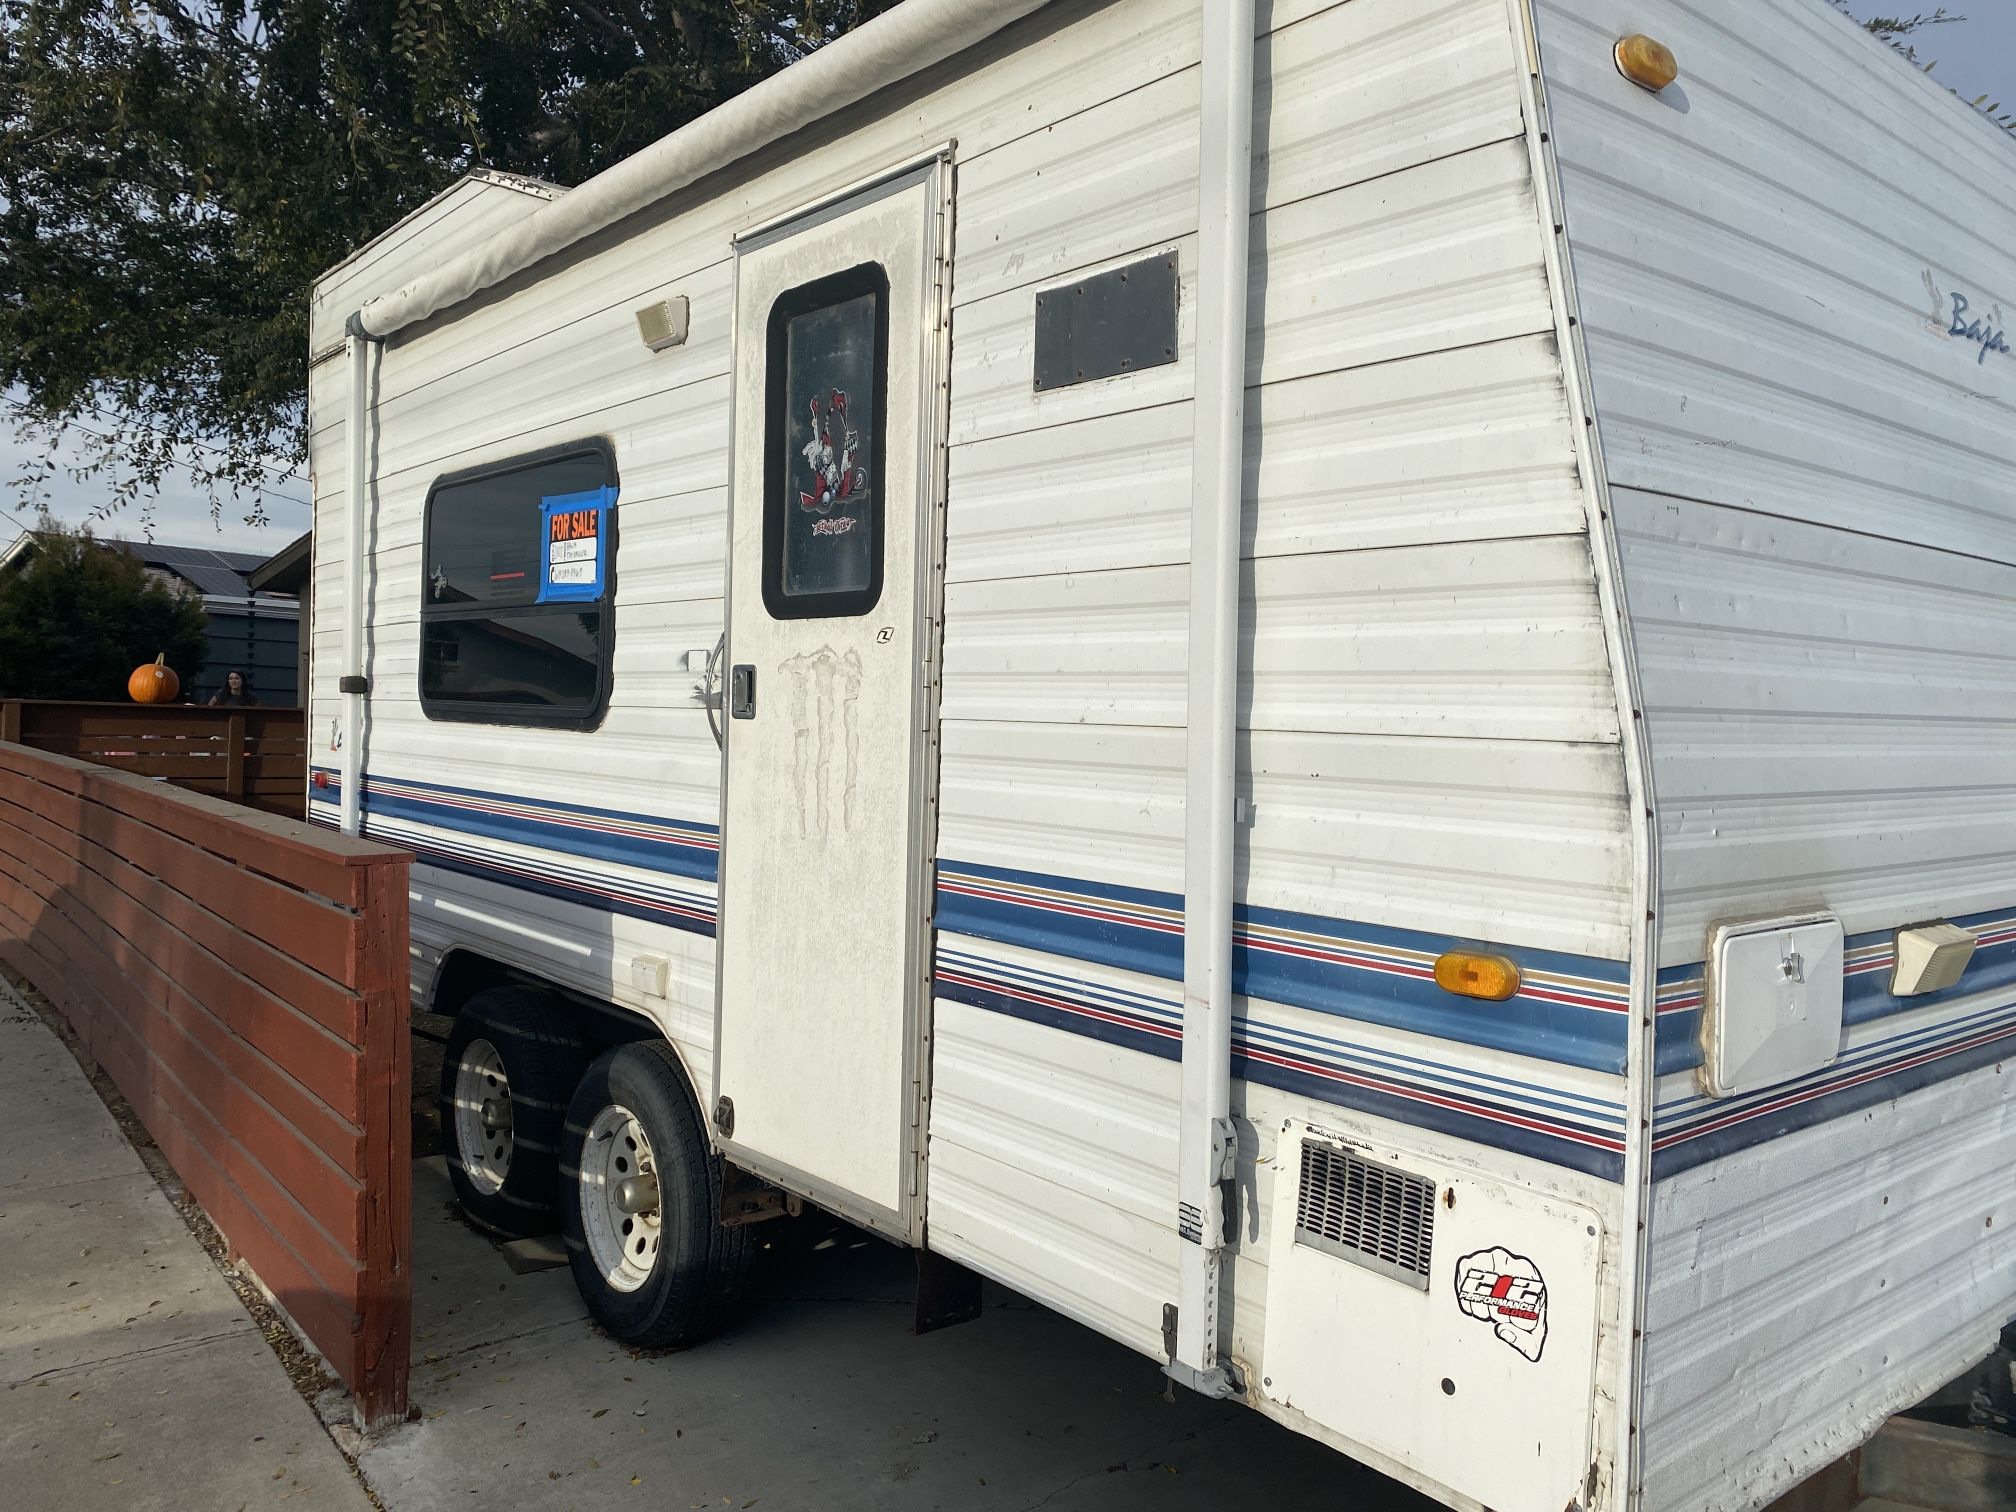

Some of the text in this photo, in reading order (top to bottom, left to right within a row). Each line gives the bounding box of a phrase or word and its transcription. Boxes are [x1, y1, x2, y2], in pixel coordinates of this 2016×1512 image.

[1948, 292, 2010, 365] Baja
[551, 509, 597, 541] FOR SALE
[1459, 1291, 1535, 1312] PERFORMANCE
[1497, 1306, 1539, 1320] GLOVES
